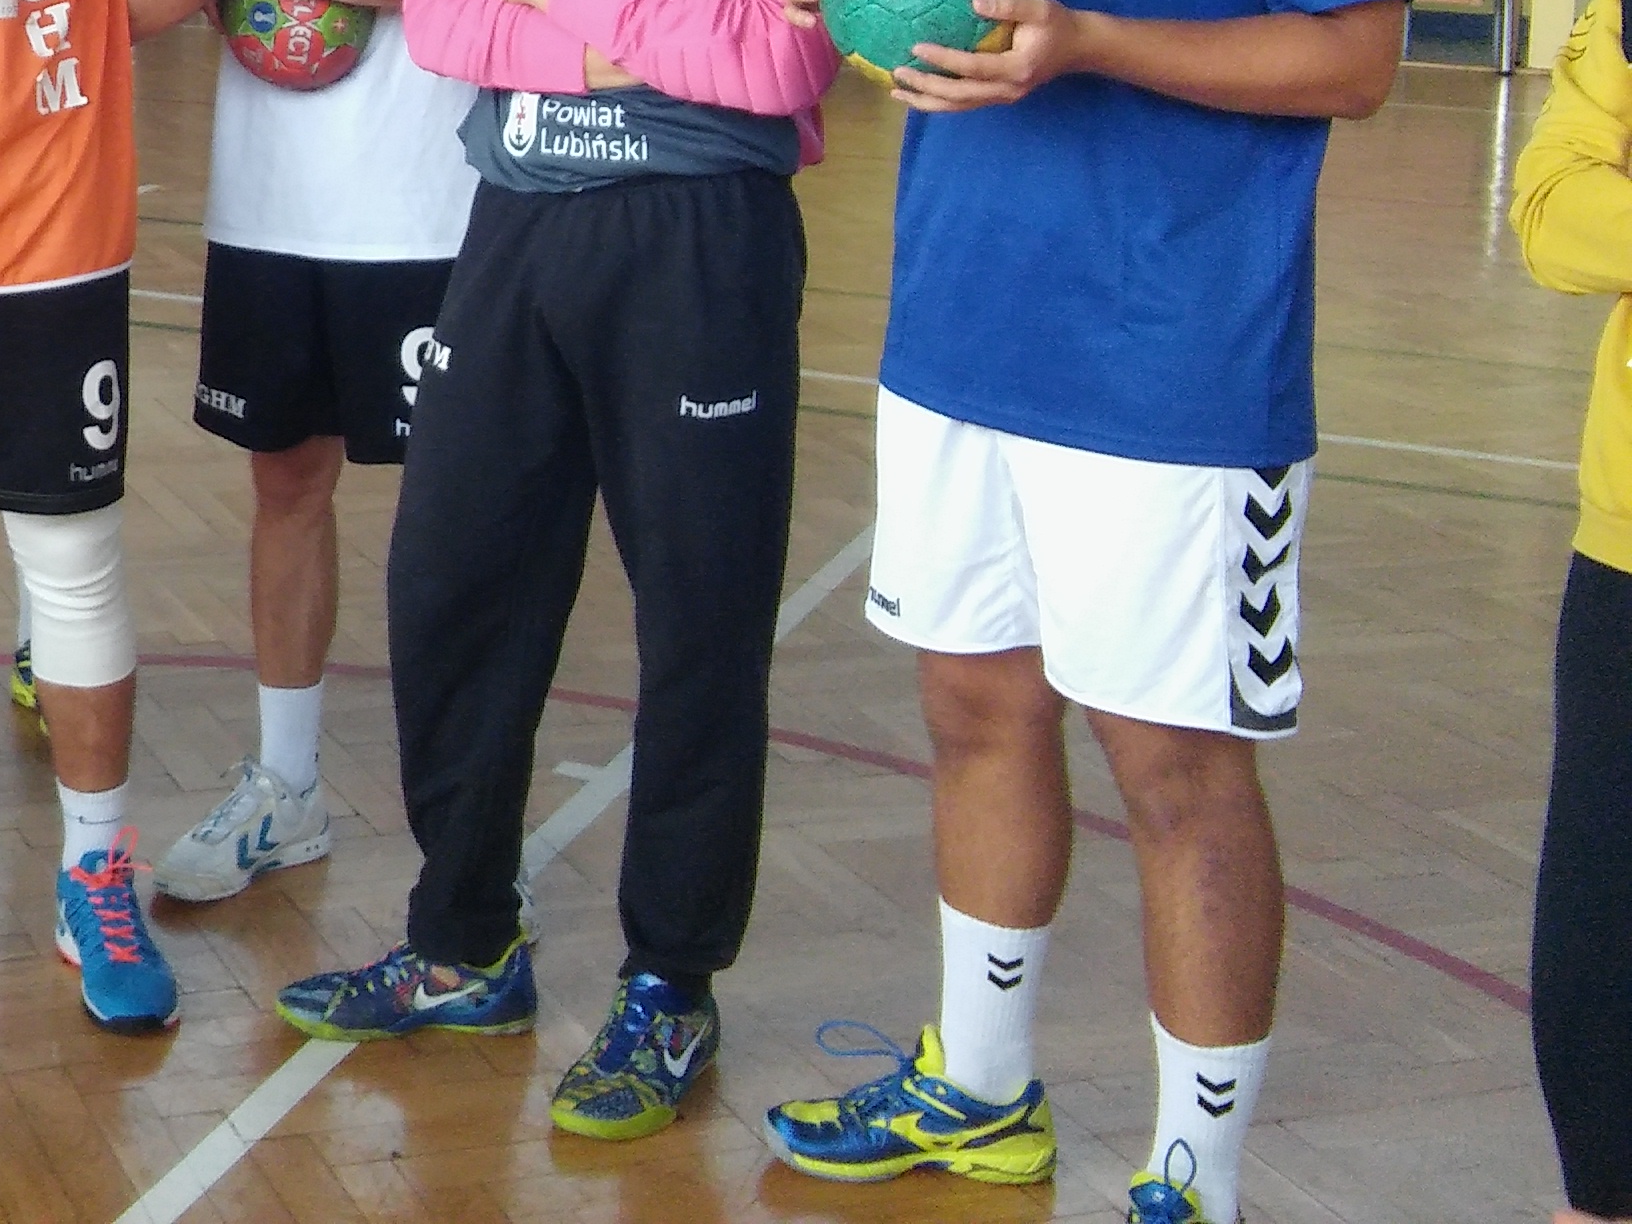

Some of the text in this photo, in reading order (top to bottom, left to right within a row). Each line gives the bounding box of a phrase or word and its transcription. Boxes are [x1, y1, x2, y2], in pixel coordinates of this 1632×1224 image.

[542, 98, 626, 128] Powiat
[540, 126, 649, 162] Lubiński
[82, 359, 121, 451] 9
[679, 389, 757, 419] hummel
